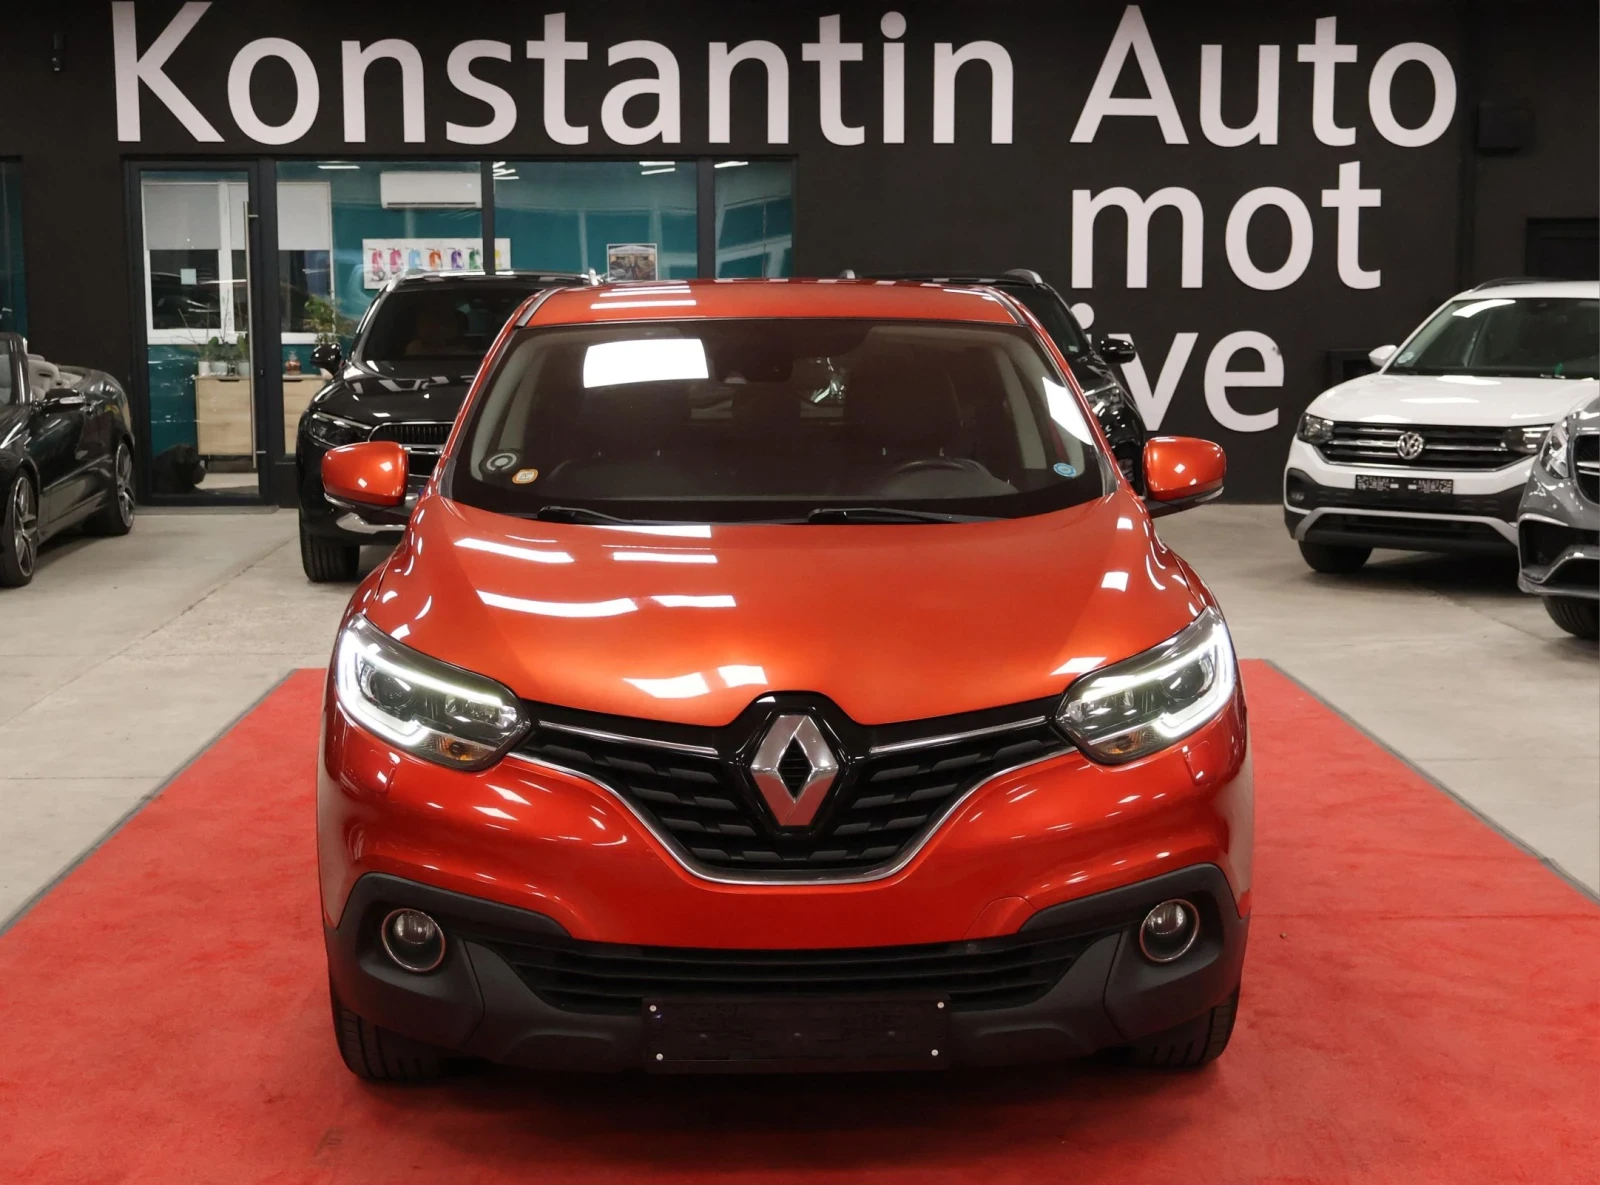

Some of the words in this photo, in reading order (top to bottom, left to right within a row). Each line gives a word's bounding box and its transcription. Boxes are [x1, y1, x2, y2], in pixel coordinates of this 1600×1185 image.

[112, 1, 1015, 146] Konstantin
[1069, 4, 1458, 148] Auto
[1071, 160, 1382, 291] mot
[1070, 302, 1285, 433] ve
